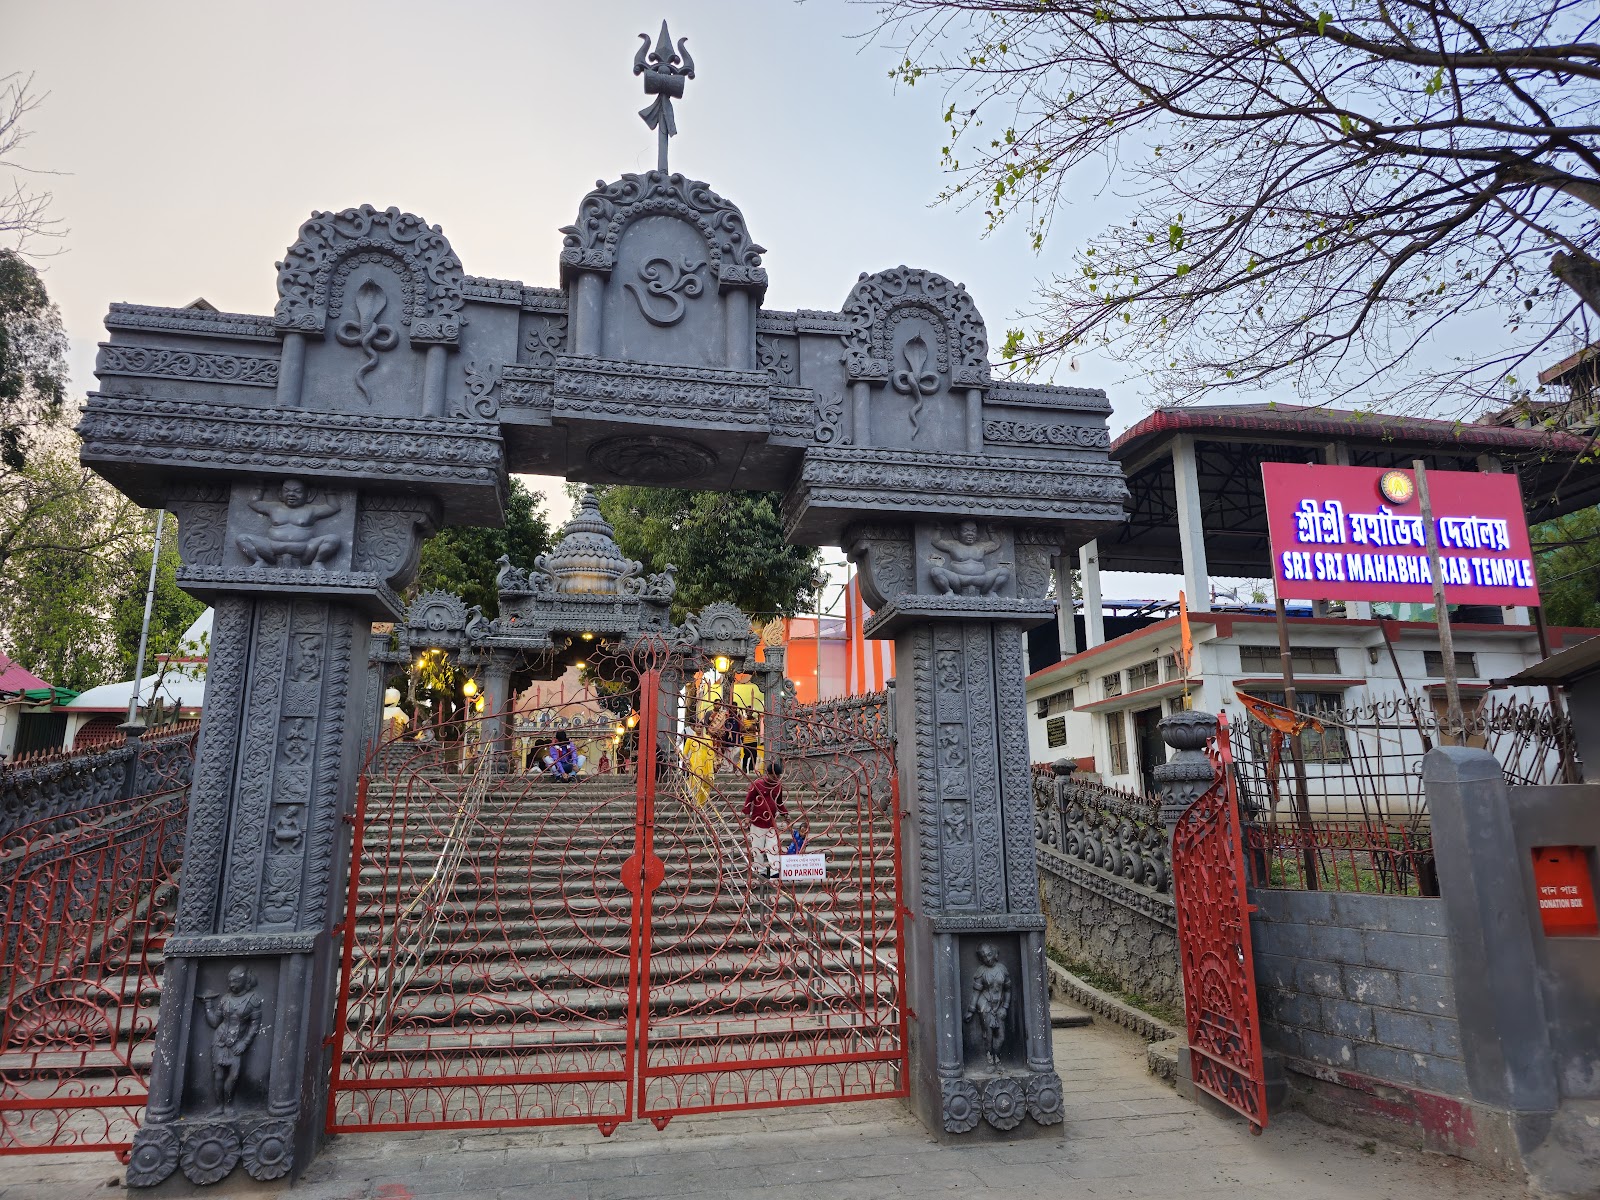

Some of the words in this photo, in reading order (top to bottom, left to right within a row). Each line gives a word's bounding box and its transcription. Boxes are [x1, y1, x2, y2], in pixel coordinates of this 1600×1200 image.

[1282, 551, 1313, 580] SRI
[1314, 551, 1345, 581] SRI
[1346, 553, 1471, 585] MAHABHARAB
[1471, 557, 1534, 587] TEMPLE
[783, 869, 793, 877] NO
[794, 868, 824, 877] PARKING
[1540, 886, 1557, 895] দান
[1539, 899, 1570, 908] DONATION
[1570, 898, 1583, 908] BOX
